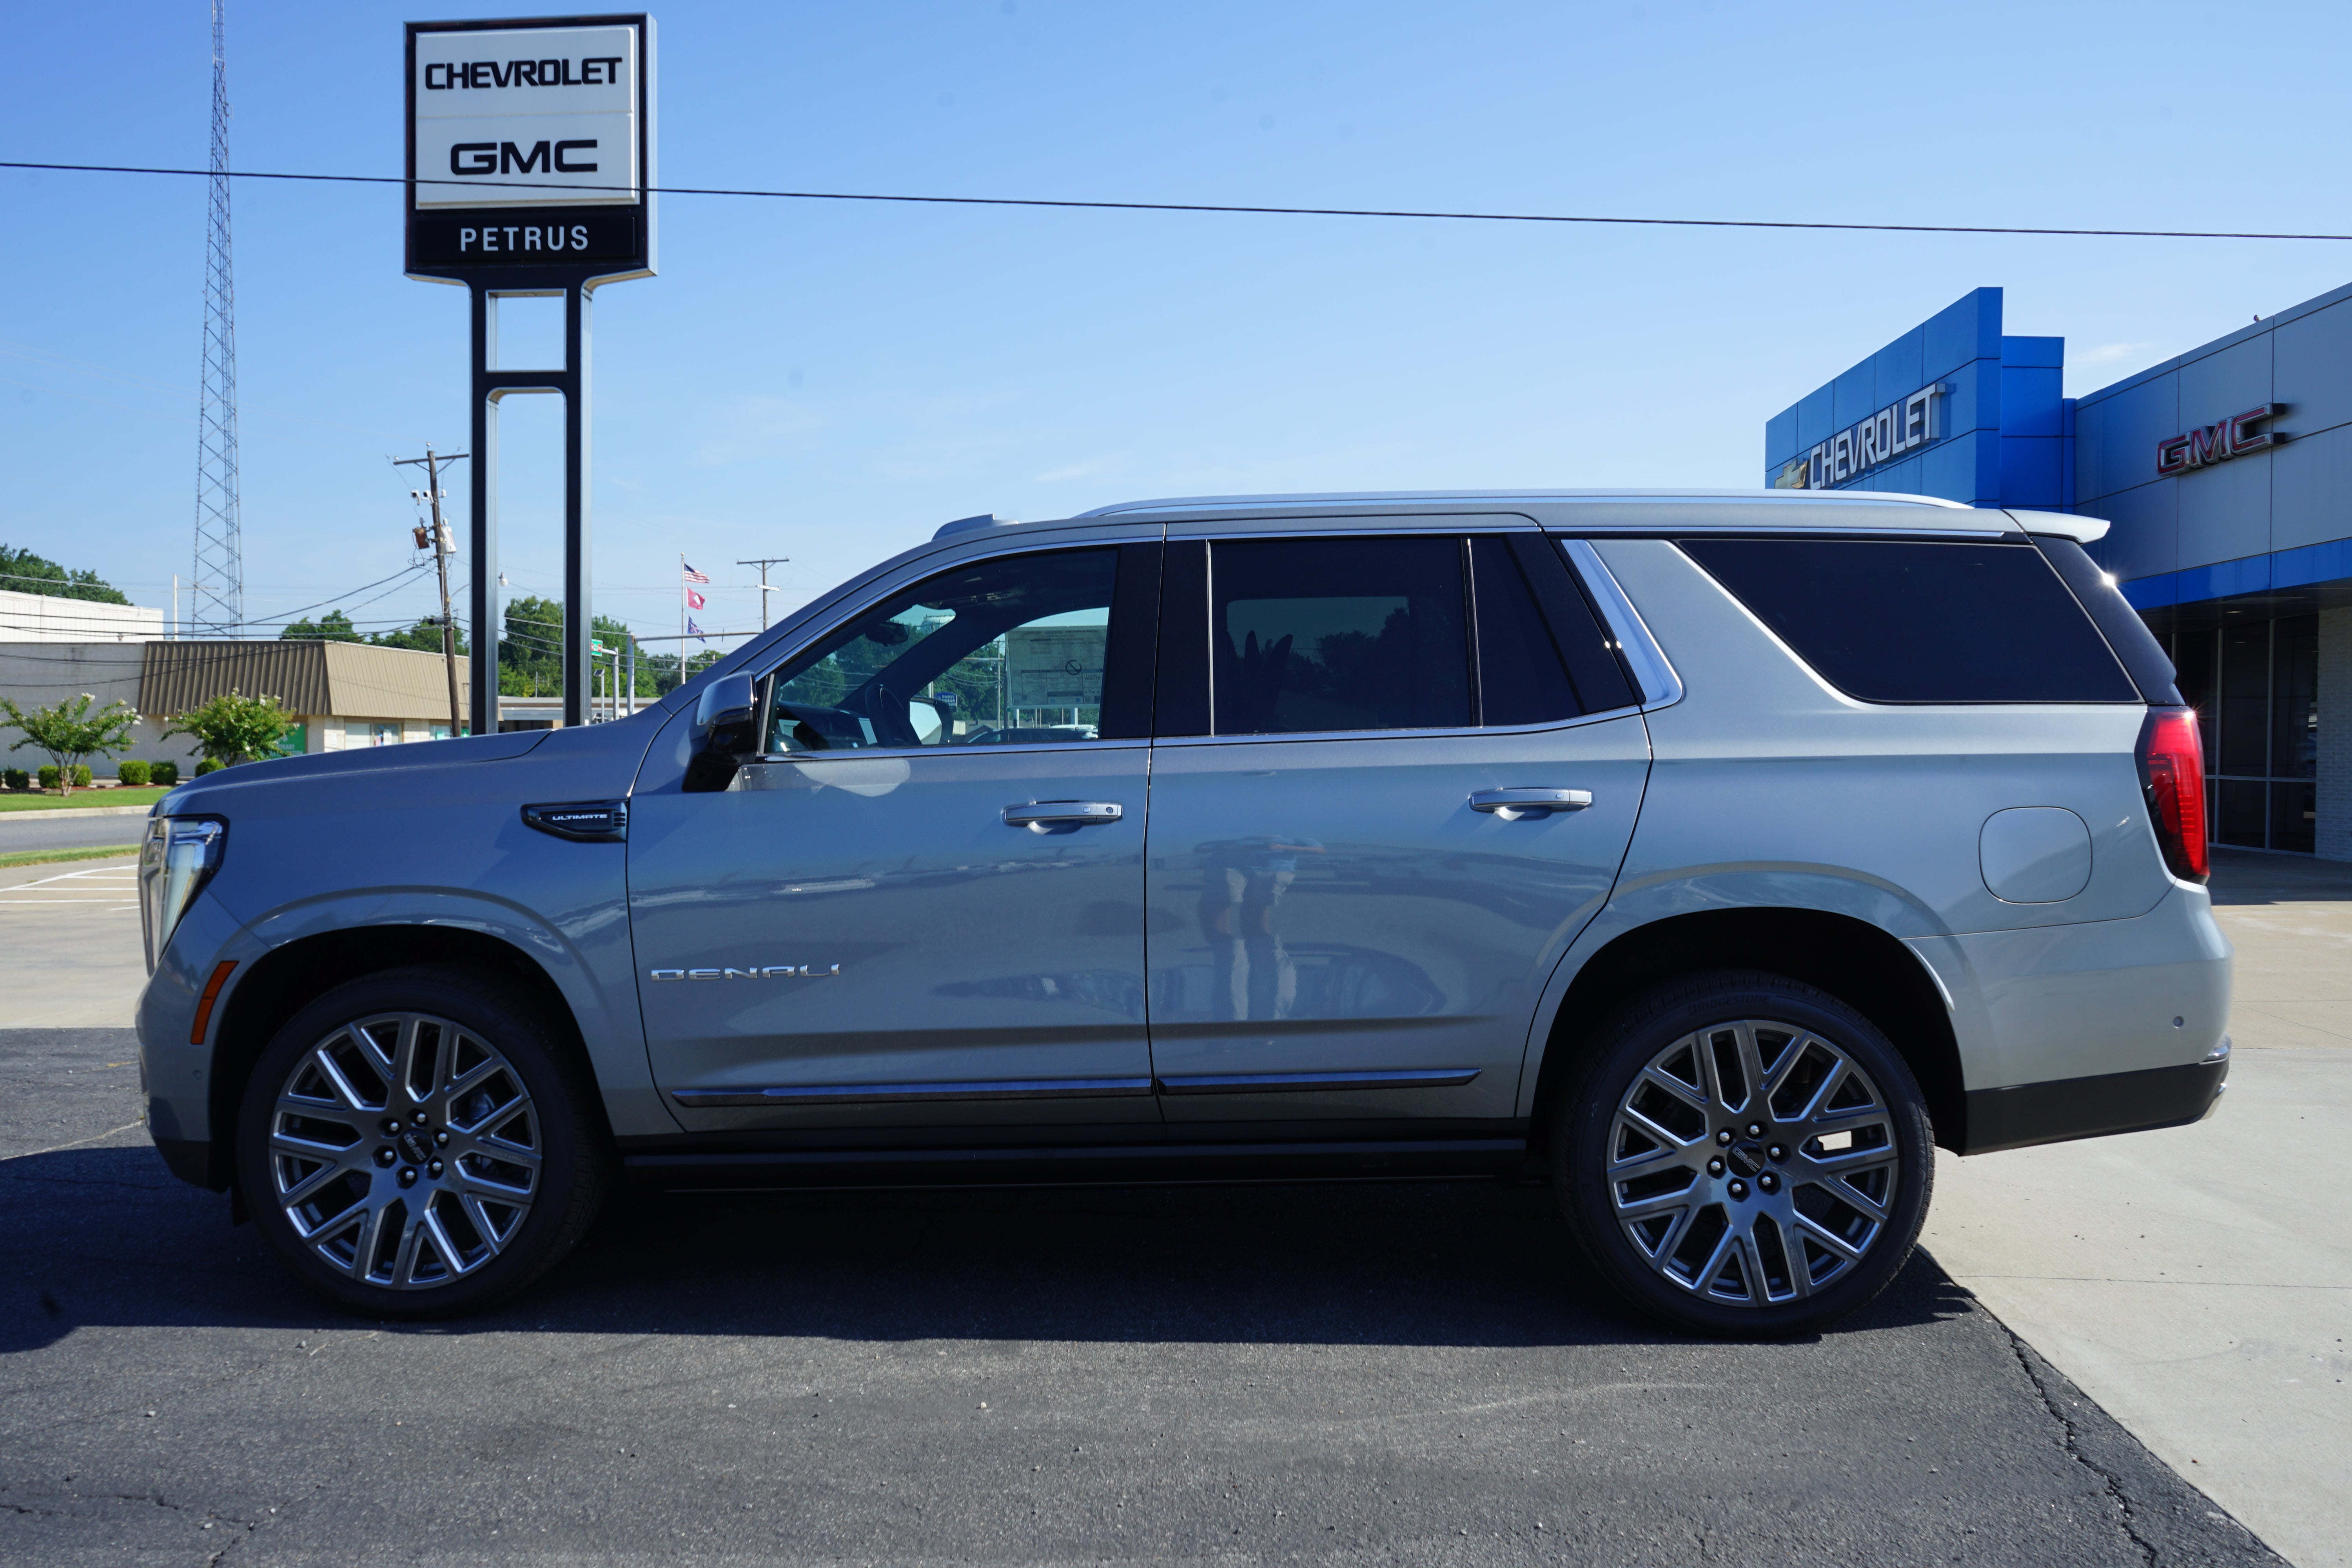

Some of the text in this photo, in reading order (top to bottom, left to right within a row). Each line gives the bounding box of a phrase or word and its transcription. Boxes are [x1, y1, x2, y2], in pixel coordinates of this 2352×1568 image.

[425, 57, 622, 90] CHEVROLET
[450, 139, 598, 175] GMC
[461, 225, 588, 252] PETRUS
[1810, 383, 1940, 490] CHEVROLET
[2157, 402, 2274, 477] GMC
[651, 963, 840, 981] DENALI
[1687, 994, 1770, 1016] BRIDGESTONE
[404, 1133, 426, 1161] GMC
[1733, 1147, 1760, 1172] GMC
